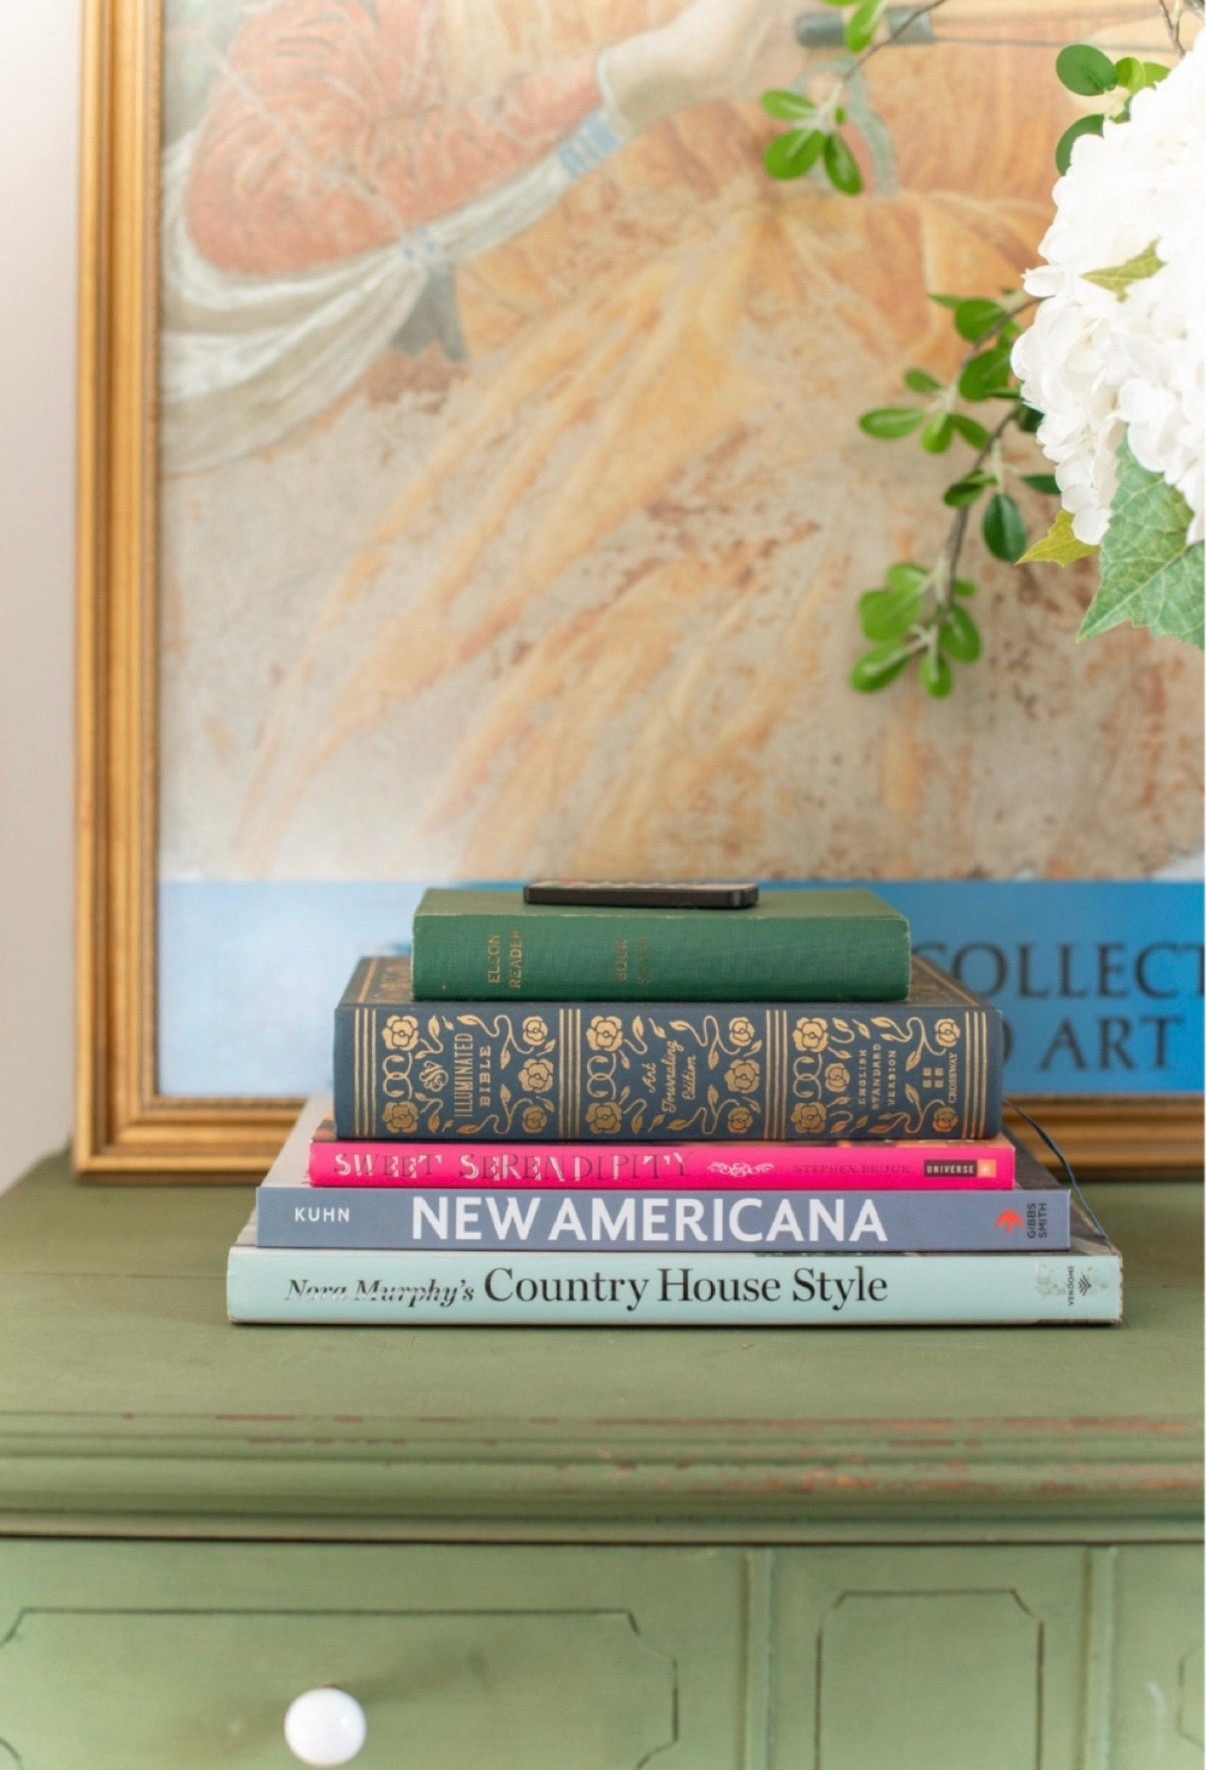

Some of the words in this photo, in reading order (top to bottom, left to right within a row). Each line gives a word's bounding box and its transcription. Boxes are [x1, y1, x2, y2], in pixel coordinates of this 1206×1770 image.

[1040, 1015, 1185, 1071] ART
[454, 1033, 473, 1117] ILLUMINATED
[479, 1046, 491, 1107] BIBLE
[641, 1062, 656, 1093] Art
[660, 1040, 684, 1113] Journaling
[681, 1055, 696, 1100] Edition
[858, 1049, 866, 1105] ENGLISH
[872, 1043, 881, 1110] STANDARD
[887, 1050, 896, 1105] VERSION
[948, 1052, 957, 1104] CROSSWAY
[334, 1153, 442, 1178] SWEET
[458, 1152, 692, 1182] SERENDIPITY
[926, 1164, 974, 1174] UNIVERSE
[294, 1207, 350, 1222] KUHN
[412, 1197, 543, 1240] NEW
[549, 1198, 888, 1241] AMERICANA
[1027, 1202, 1036, 1239] GIBBS
[1037, 1202, 1047, 1239] SMITH
[485, 1267, 650, 1311] Country
[657, 1267, 781, 1302] House
[793, 1266, 888, 1310] Style
[1066, 1266, 1075, 1306] VENDOME
